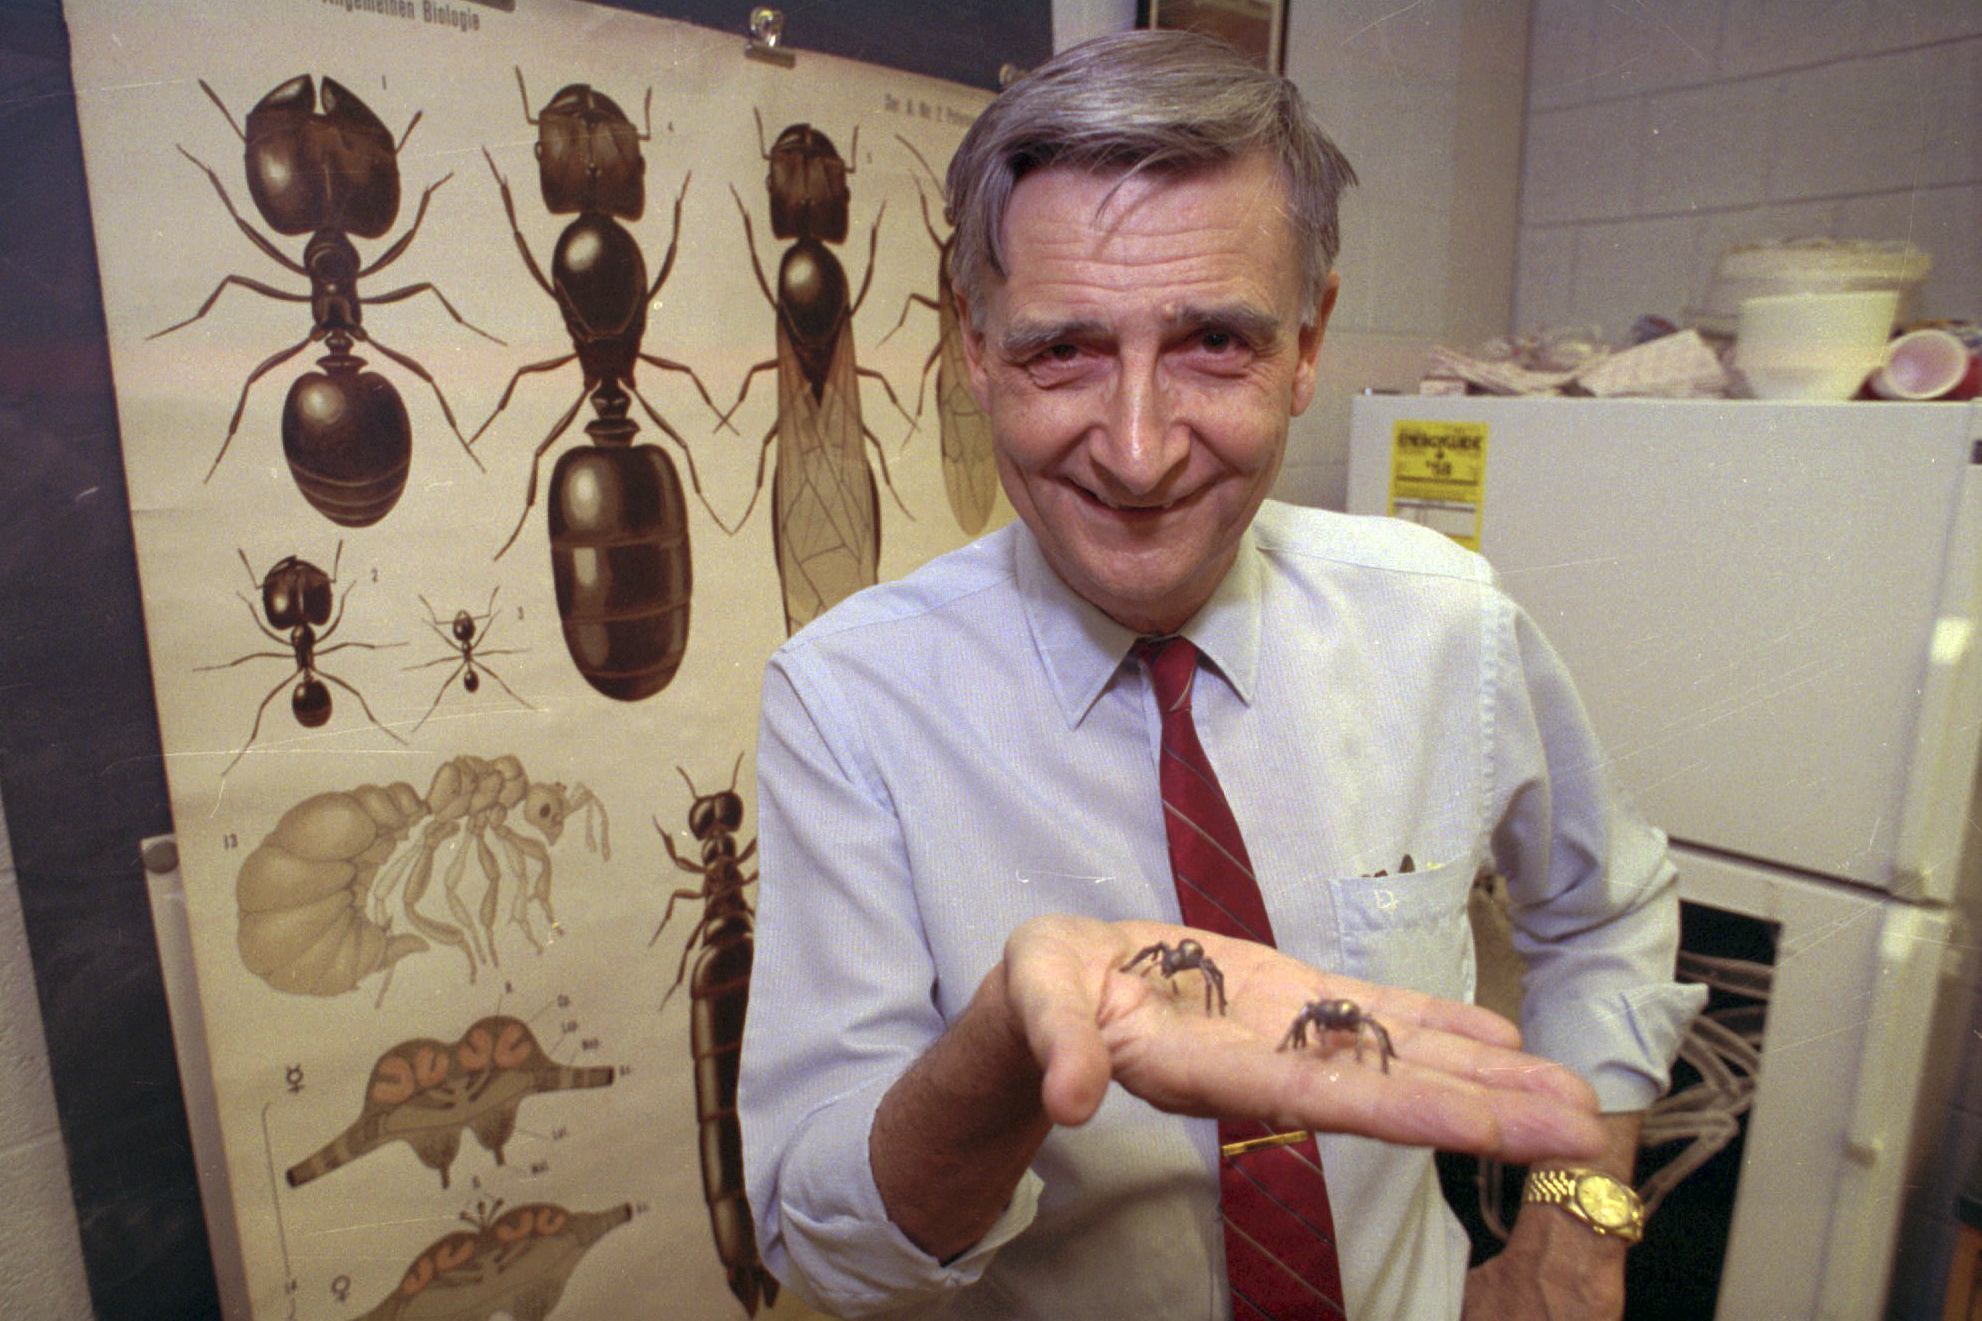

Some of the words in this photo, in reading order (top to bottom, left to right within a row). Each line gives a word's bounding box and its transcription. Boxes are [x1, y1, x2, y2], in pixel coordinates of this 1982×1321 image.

[322, 0, 415, 19] gemeinen
[423, 0, 480, 32] Biologie
[371, 568, 379, 583] 2
[223, 833, 239, 850] 13
